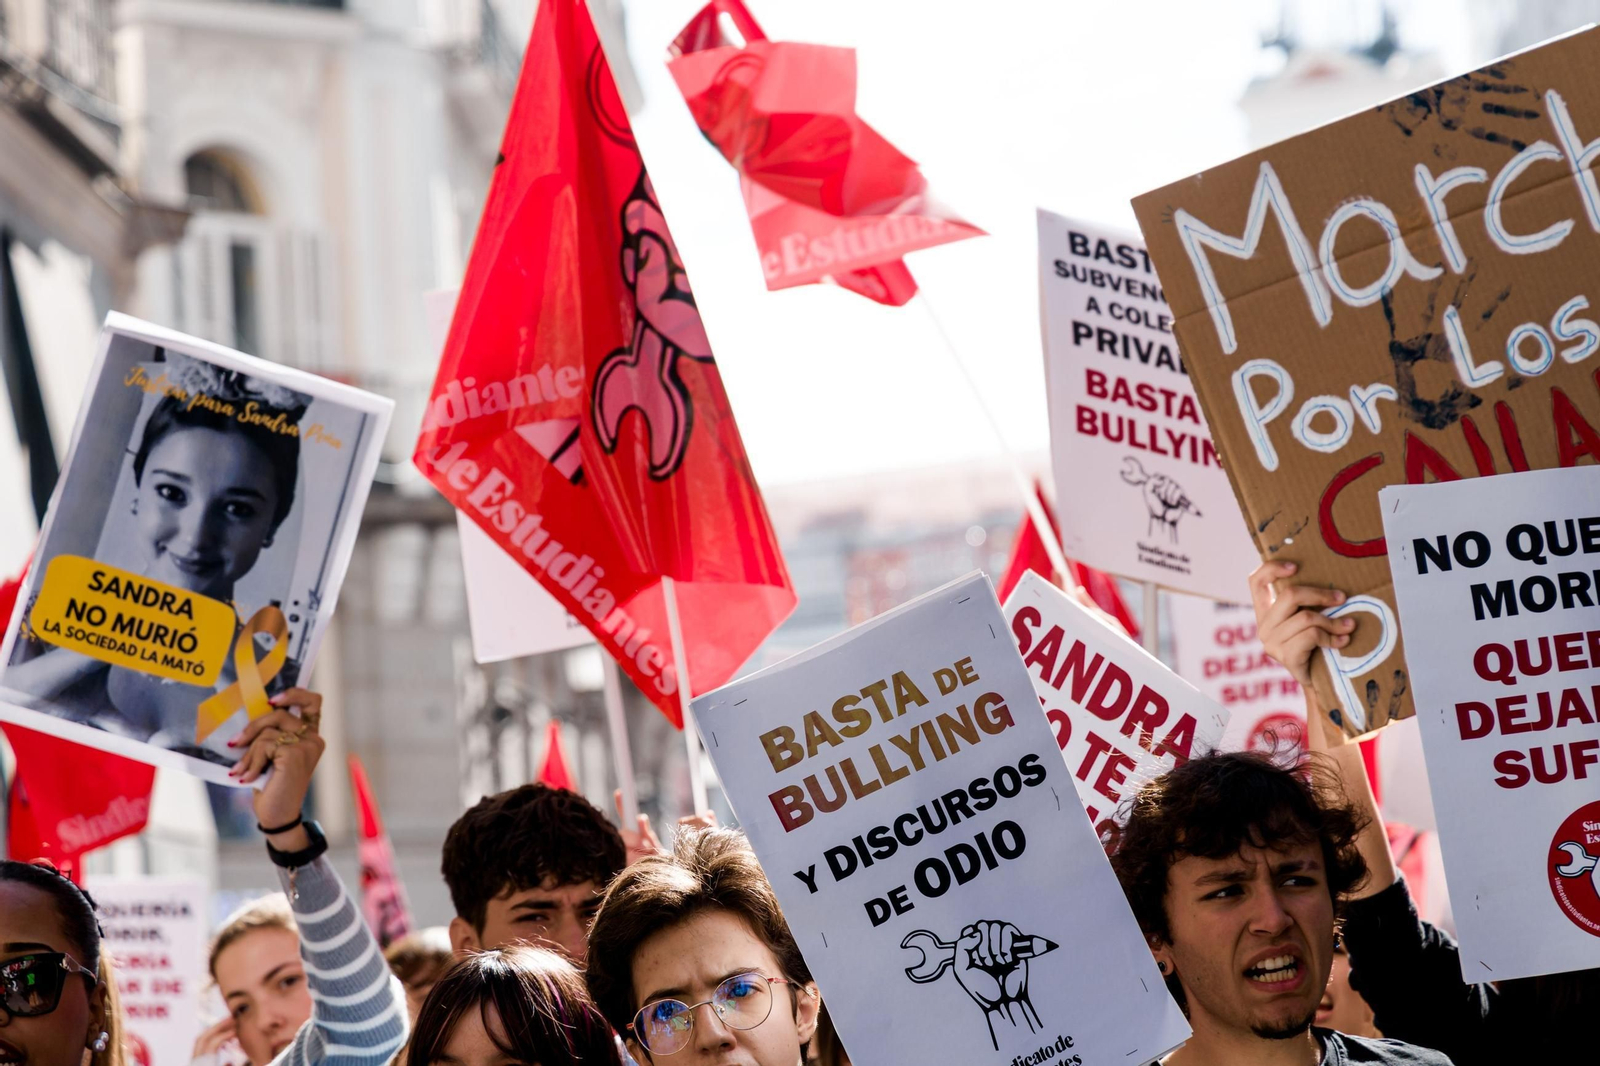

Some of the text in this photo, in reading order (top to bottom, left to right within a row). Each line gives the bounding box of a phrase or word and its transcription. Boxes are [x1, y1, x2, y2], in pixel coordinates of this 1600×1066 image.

[1086, 296, 1171, 334] A COLE
[1072, 320, 1188, 376] PRIVA
[421, 363, 585, 433] diante
[1086, 368, 1201, 425] BASTA
[1231, 295, 1599, 471] Por Los
[187, 393, 235, 417] para
[237, 402, 300, 437] Sandra
[466, 467, 679, 696] Estudiantes
[1413, 531, 1491, 574] NO
[88, 570, 193, 620] SANDRA
[43, 619, 205, 677] LA SOCIEDAD LA MATÓ
[65, 597, 198, 654] NO MURIÓ
[759, 656, 980, 773] BASTA DE
[1012, 606, 1197, 768] SANDRA
[1455, 685, 1600, 741] DEJA
[768, 691, 1015, 833] BULLYING
[1039, 696, 1138, 804] O TE
[793, 864, 818, 894] Y
[823, 753, 1047, 882] DISCURSOS
[863, 885, 915, 927] DE
[914, 820, 1027, 898] ODIO
[1055, 1034, 1075, 1054] de
